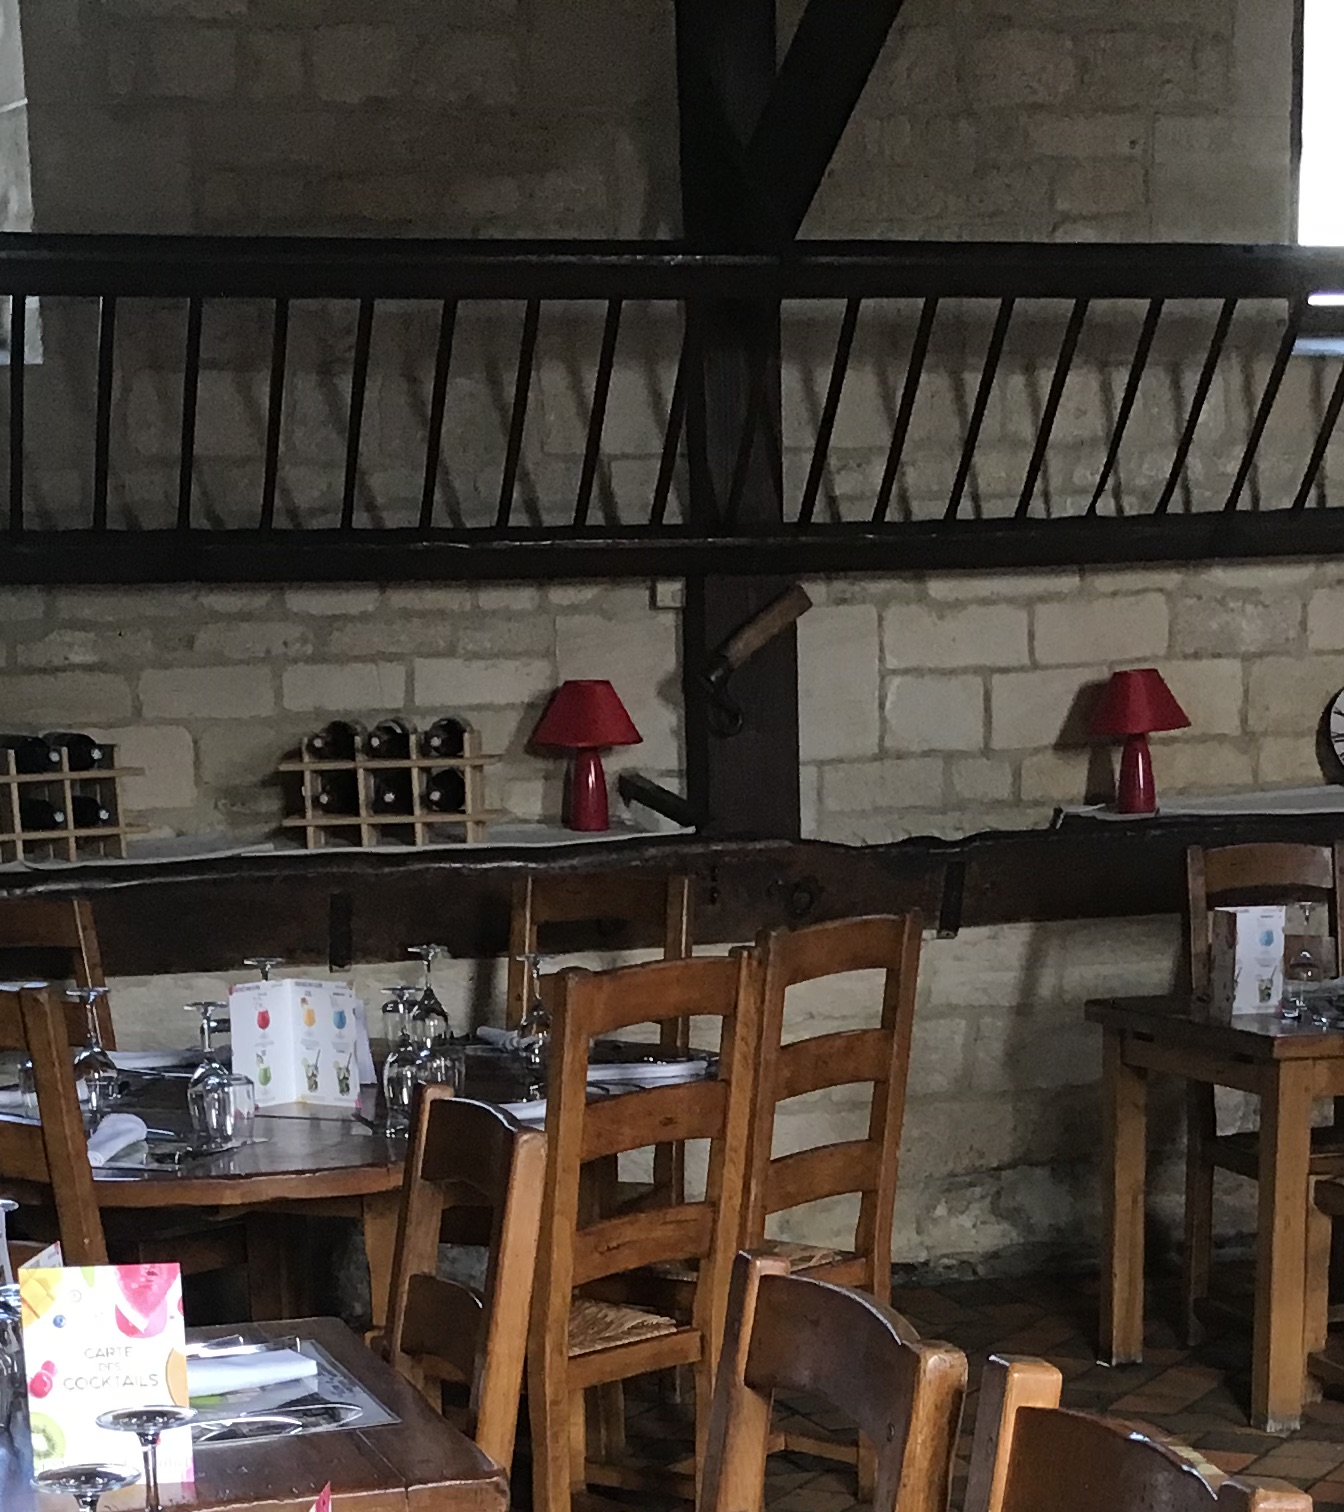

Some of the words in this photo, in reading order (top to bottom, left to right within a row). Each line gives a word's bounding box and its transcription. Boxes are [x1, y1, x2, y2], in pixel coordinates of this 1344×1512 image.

[84, 1346, 133, 1359] CARTE
[99, 1361, 121, 1371] DES
[63, 1373, 159, 1391] COCKTAILS
